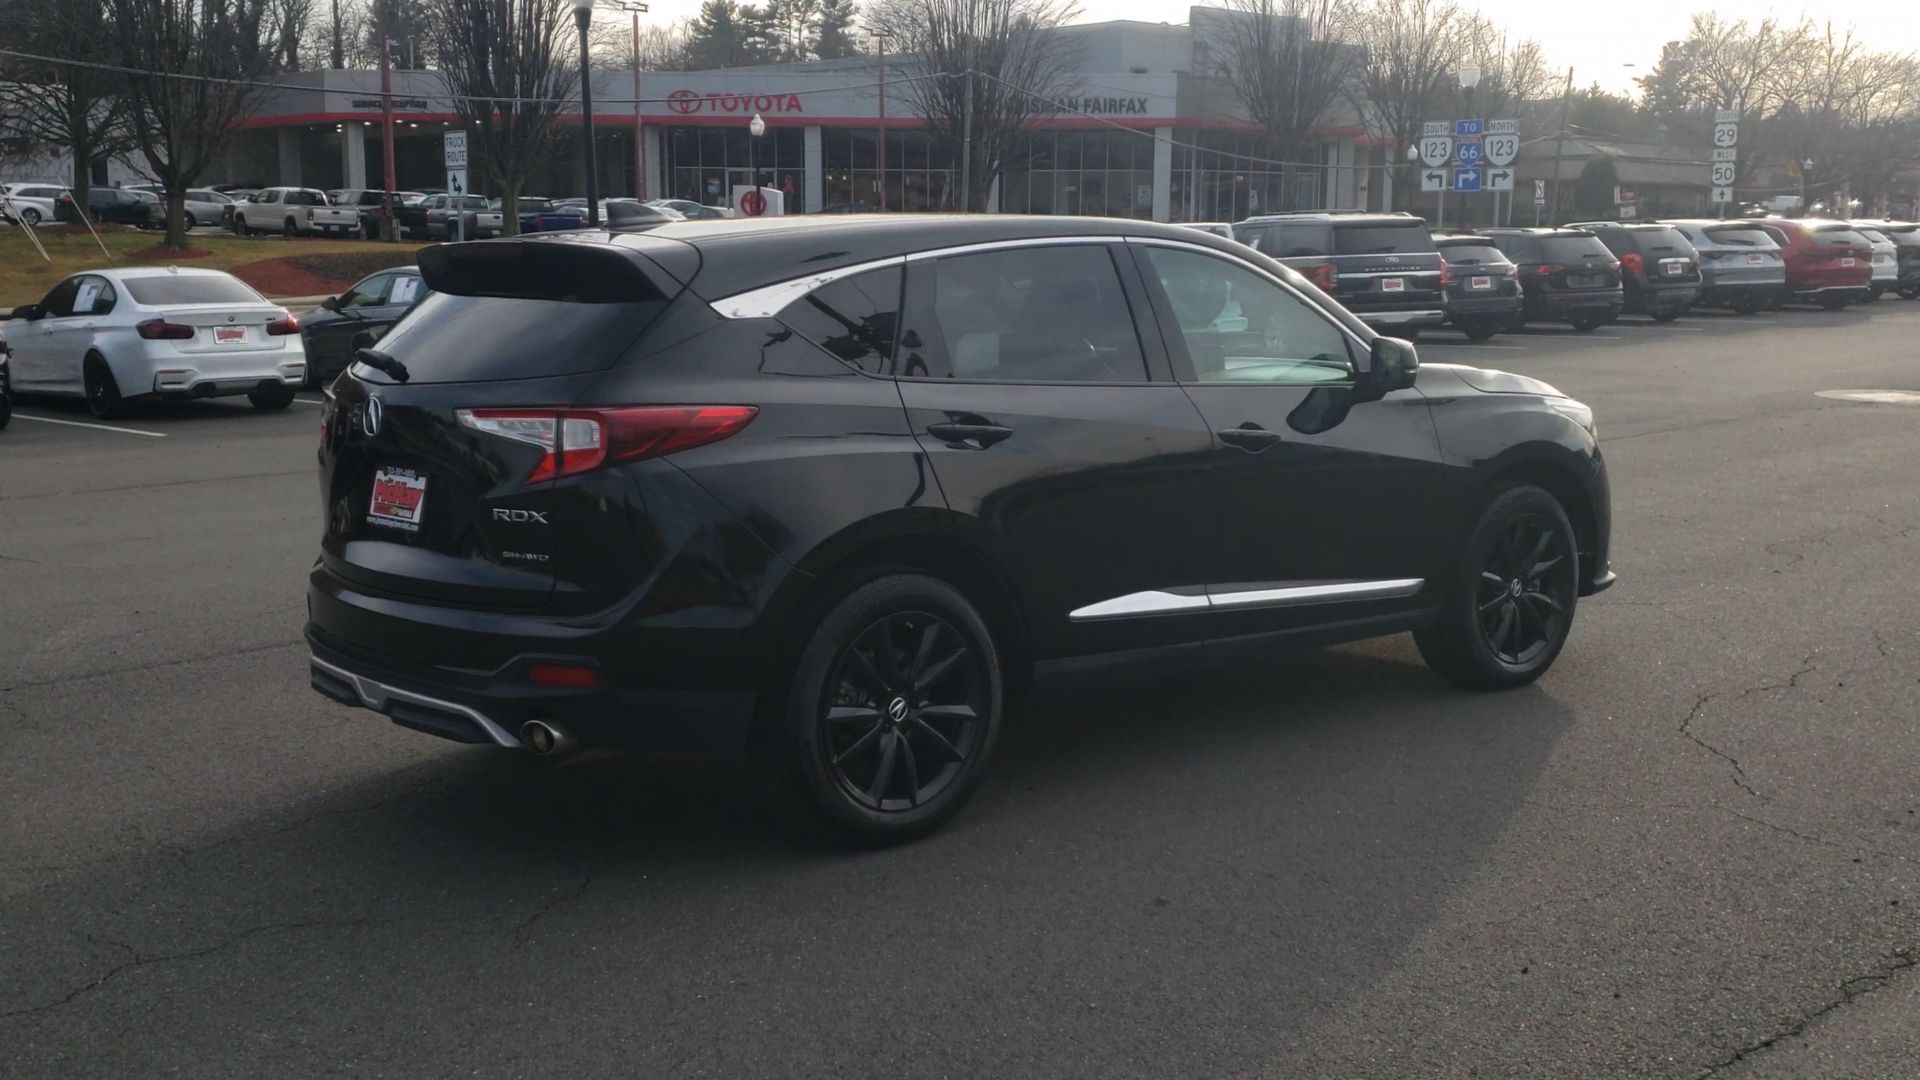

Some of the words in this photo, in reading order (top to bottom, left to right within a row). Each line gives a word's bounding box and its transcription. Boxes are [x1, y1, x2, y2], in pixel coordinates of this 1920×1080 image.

[705, 92, 803, 112] TOYOTA
[1083, 98, 1148, 114] FAIRFAX
[1424, 124, 1449, 134] SOUTH
[1463, 123, 1477, 132] TO
[1490, 122, 1515, 131] NORTH
[1716, 129, 1735, 143] 29
[1424, 142, 1447, 158] 123
[1460, 145, 1478, 159] 66
[1489, 140, 1514, 157] 123
[446, 150, 466, 162] ROUTE
[1714, 167, 1733, 181] 50
[492, 508, 549, 524] RDX
